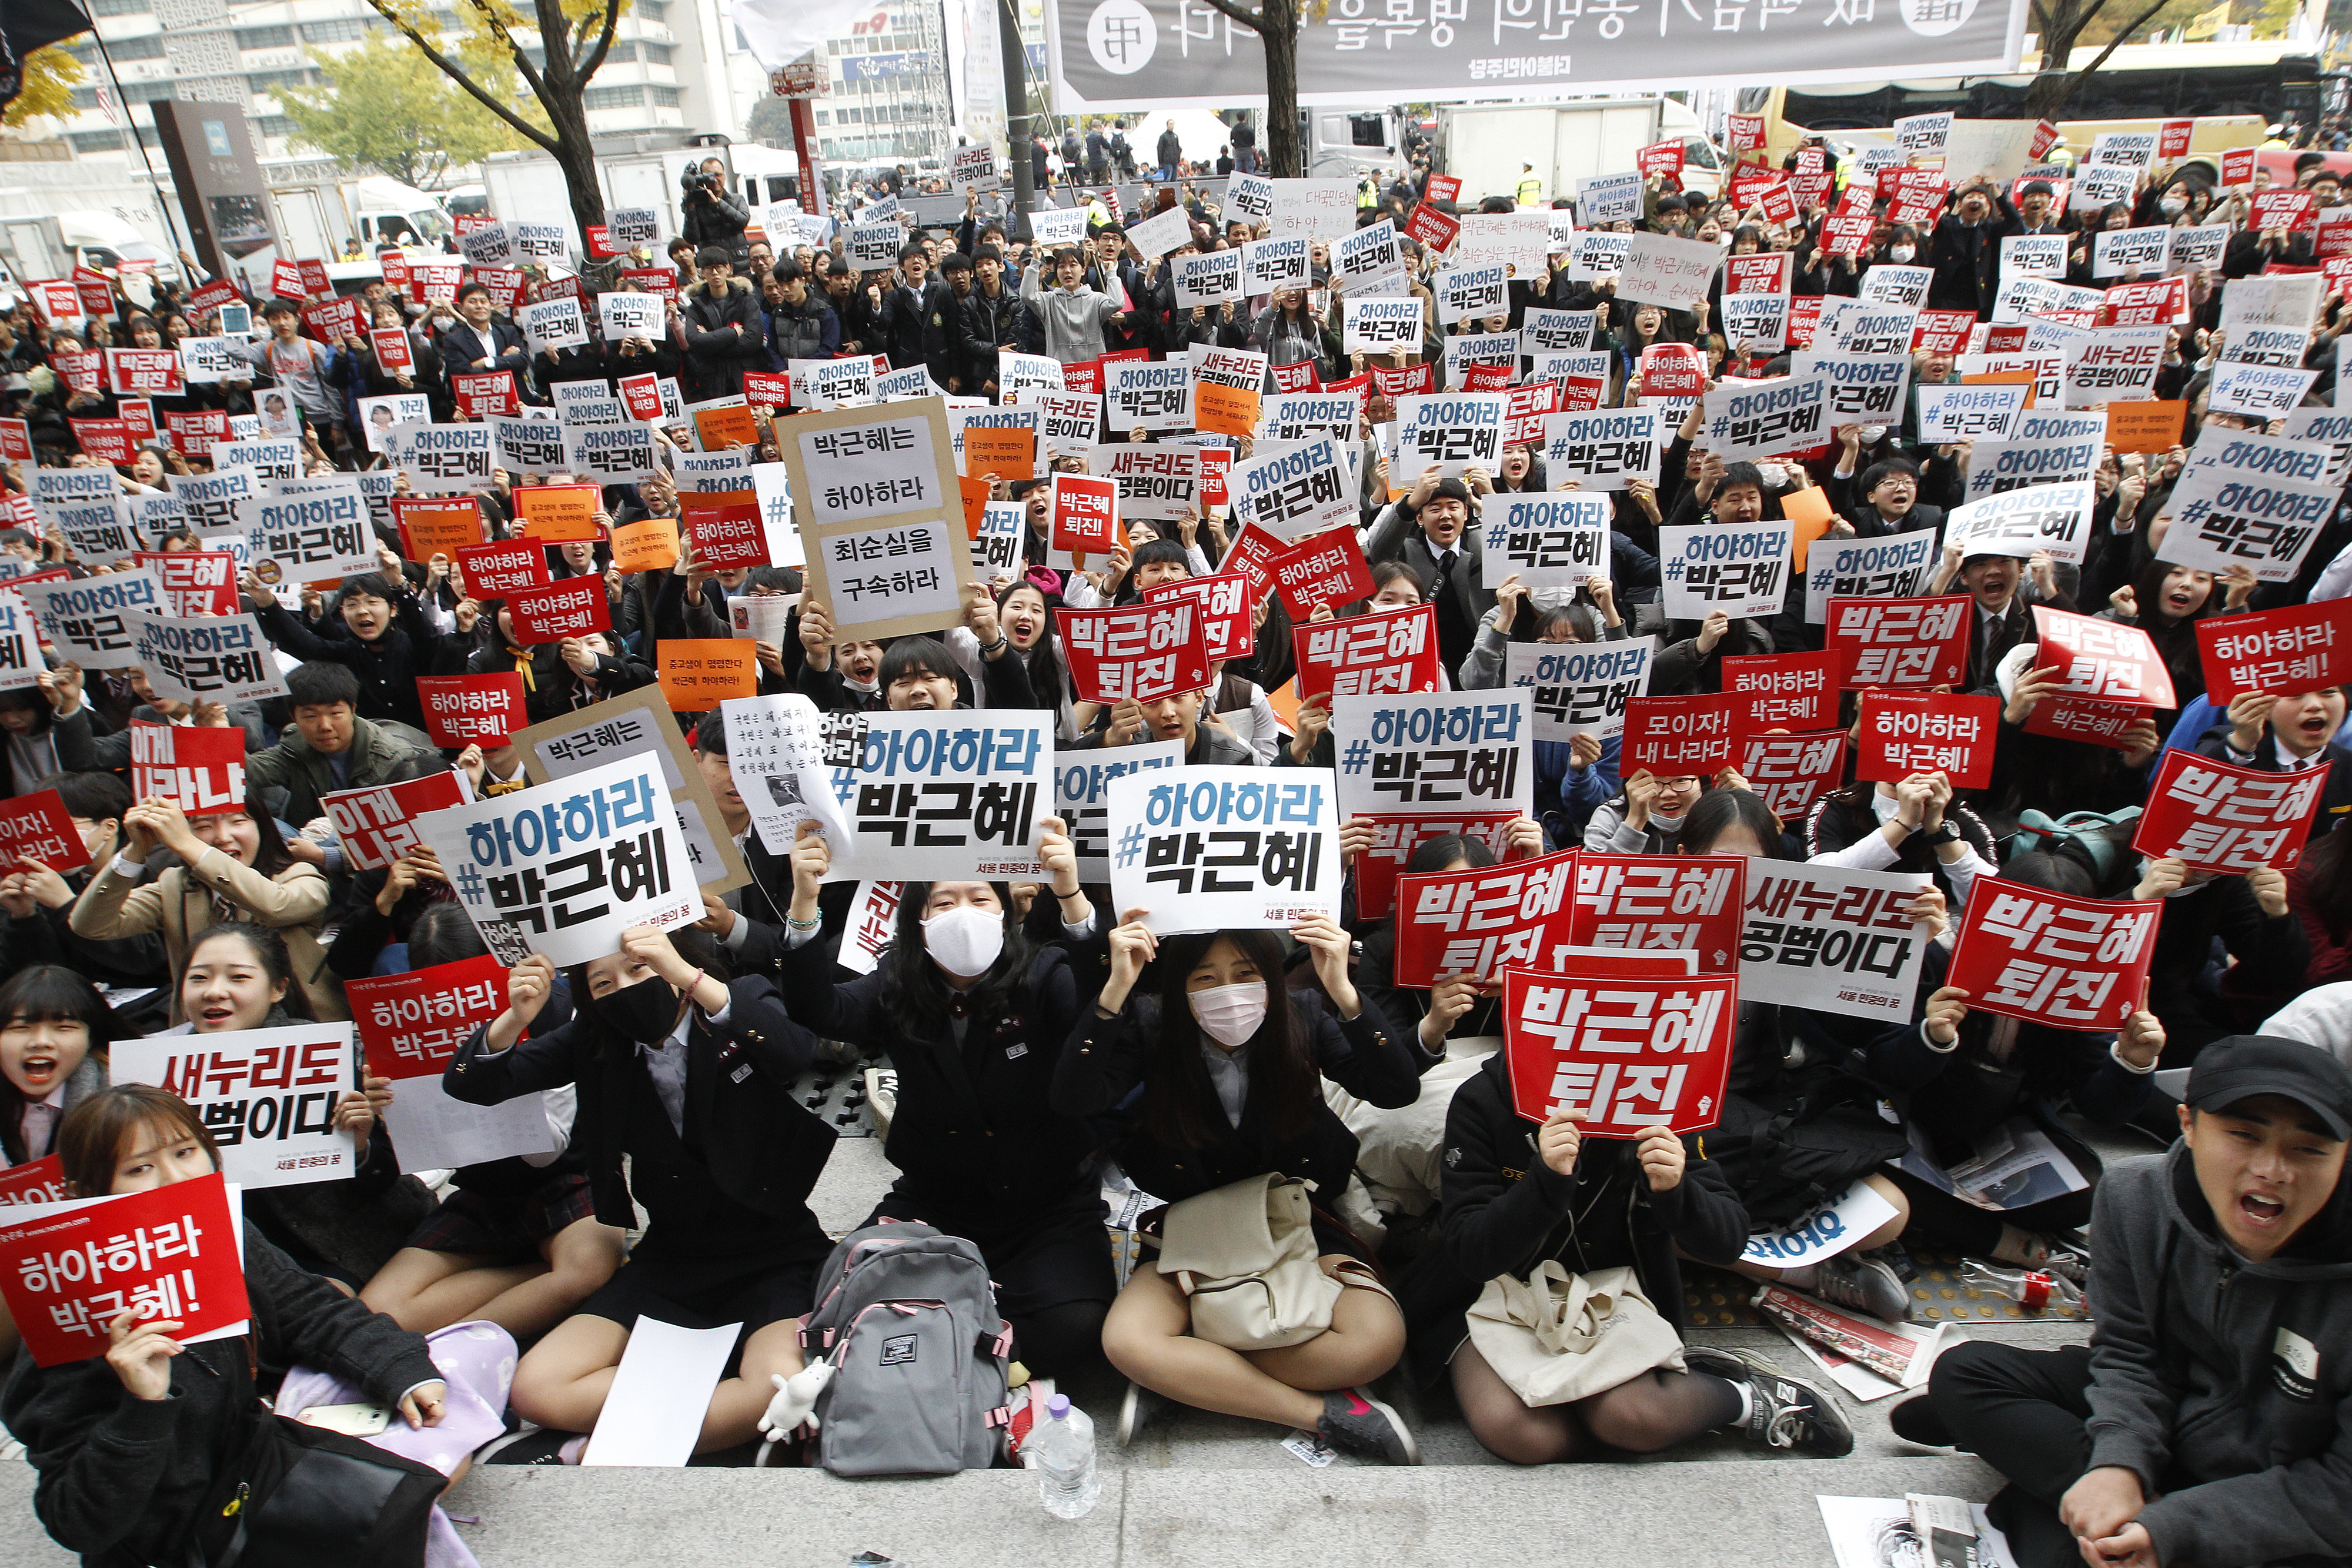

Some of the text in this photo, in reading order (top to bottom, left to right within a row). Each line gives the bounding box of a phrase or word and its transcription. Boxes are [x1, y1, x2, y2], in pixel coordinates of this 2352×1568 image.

[955, 148, 991, 164] 새누리도
[2104, 136, 2155, 151] 하야하라
[1430, 179, 1458, 192] 하야하라
[2089, 169, 2136, 185] 하야하라
[1597, 186, 1638, 203] 하야하라
[1763, 193, 1790, 207] 박근혜
[2251, 192, 2311, 212] 박근혜
[615, 210, 656, 225] 하야하라
[1043, 211, 1083, 224] 하야하라
[1462, 219, 1548, 236] 박근혜는 하야하라
[1824, 217, 1873, 237] 박근혜
[2259, 210, 2293, 230] 퇴진
[853, 225, 898, 242] 하야하라
[1341, 225, 1394, 254] 하야하라
[2109, 229, 2167, 248] 하야하라
[2177, 227, 2226, 246] 하야하라
[1462, 246, 1548, 268] 최순실은 구속하라
[413, 267, 460, 285] 박근혜
[476, 269, 520, 287] 박근혜
[611, 296, 662, 311] 하야하라
[2107, 285, 2171, 309] 박근혜
[306, 304, 357, 324] 박근혜
[1853, 313, 1915, 335] 하야하라
[1458, 337, 1516, 357] 하야하라
[2245, 330, 2306, 350] 하야하라
[55, 352, 101, 374] 박근혜
[1202, 352, 1264, 376] 새누리도
[2082, 345, 2161, 366] 새누리도
[818, 362, 870, 380] 하야하라
[877, 371, 926, 397] 하야하라
[2236, 370, 2306, 390] 하야하라
[457, 376, 511, 395] 박근혜
[749, 391, 786, 404] 하야하라
[1729, 376, 1824, 417] 하야하라
[171, 415, 225, 434] 박근혜
[1279, 401, 1355, 422] 하야하라
[1418, 401, 1501, 426] 하야하라
[500, 423, 562, 442] 하야하라
[584, 430, 650, 449] 하야하라
[814, 424, 916, 459] 박근혜는
[1568, 414, 1654, 441] 하야하라
[1111, 453, 1192, 473] 새누리도
[1247, 439, 1334, 493] 하야하라
[1998, 443, 2094, 473] 하야하라
[2221, 440, 2327, 482] 하야하라
[38, 473, 112, 493] 하야하라
[824, 476, 924, 511] 하야하라
[261, 496, 358, 530] 하야하라
[1509, 500, 1604, 530] 하야하라
[1975, 487, 2085, 520] 하야하라
[2217, 482, 2333, 523] 하야하라
[59, 507, 116, 529] 하야하라
[695, 519, 756, 541] 하야하라
[704, 541, 762, 561] 박근혜!
[834, 529, 933, 563] 최순실을
[1686, 530, 1786, 561] 하야하라
[1836, 539, 1928, 573] 하야하라
[1278, 545, 1349, 586] 하야하라
[48, 579, 153, 616] 하야하라
[841, 566, 940, 602] 구속하라
[518, 589, 594, 616] 하야하라
[532, 610, 593, 634] 박근혜!
[1070, 603, 1194, 656] 박근혜
[1837, 603, 1965, 644] 박근혜
[145, 620, 253, 654] 하야하라
[1307, 611, 1429, 667] 박근혜
[2047, 616, 2150, 661] 박근혜
[2214, 621, 2336, 661] 하야하라
[669, 659, 743, 669] 중고생이 명령한다
[1098, 653, 1179, 701] 퇴진
[1536, 647, 1646, 683] 하야하라
[1850, 646, 1940, 684] 퇴진
[2065, 656, 2144, 698] 퇴진
[2229, 654, 2330, 690] 박근혜!
[672, 677, 740, 686] 박근혜 하야하라!
[430, 688, 512, 714] 하야하라
[1371, 702, 1522, 747] 하야하라
[1645, 710, 1730, 736] 모이자!
[1876, 711, 1981, 742] 하야하라
[2052, 708, 2127, 737] 박근혜!
[131, 724, 176, 766] 이게
[549, 718, 643, 761] 박근혜는
[862, 727, 1042, 777] 하야하라
[1884, 742, 1970, 773] 박근혜!
[1145, 783, 1324, 827] 하야하라
[2166, 765, 2324, 823] 박근혜
[326, 788, 406, 834] 이게
[466, 773, 656, 868] 하야하라
[2164, 823, 2293, 869] 퇴진
[976, 862, 1043, 875] 서울 민중의 꿈
[1413, 860, 1573, 932] 박근혜
[1576, 866, 1735, 917] 박근혜
[1746, 875, 1923, 931] 새누리도
[1263, 909, 1284, 921] 서울
[1979, 892, 2156, 965] 박근혜
[1431, 924, 1545, 983] 퇴진
[370, 979, 499, 1029] 하야하라
[1992, 958, 2120, 1022] 퇴진
[1519, 986, 1726, 1055] 박근혜
[160, 1040, 342, 1098] 새누리도
[1545, 1061, 1689, 1126] 퇴진
[18, 1215, 203, 1295] 하야하라
